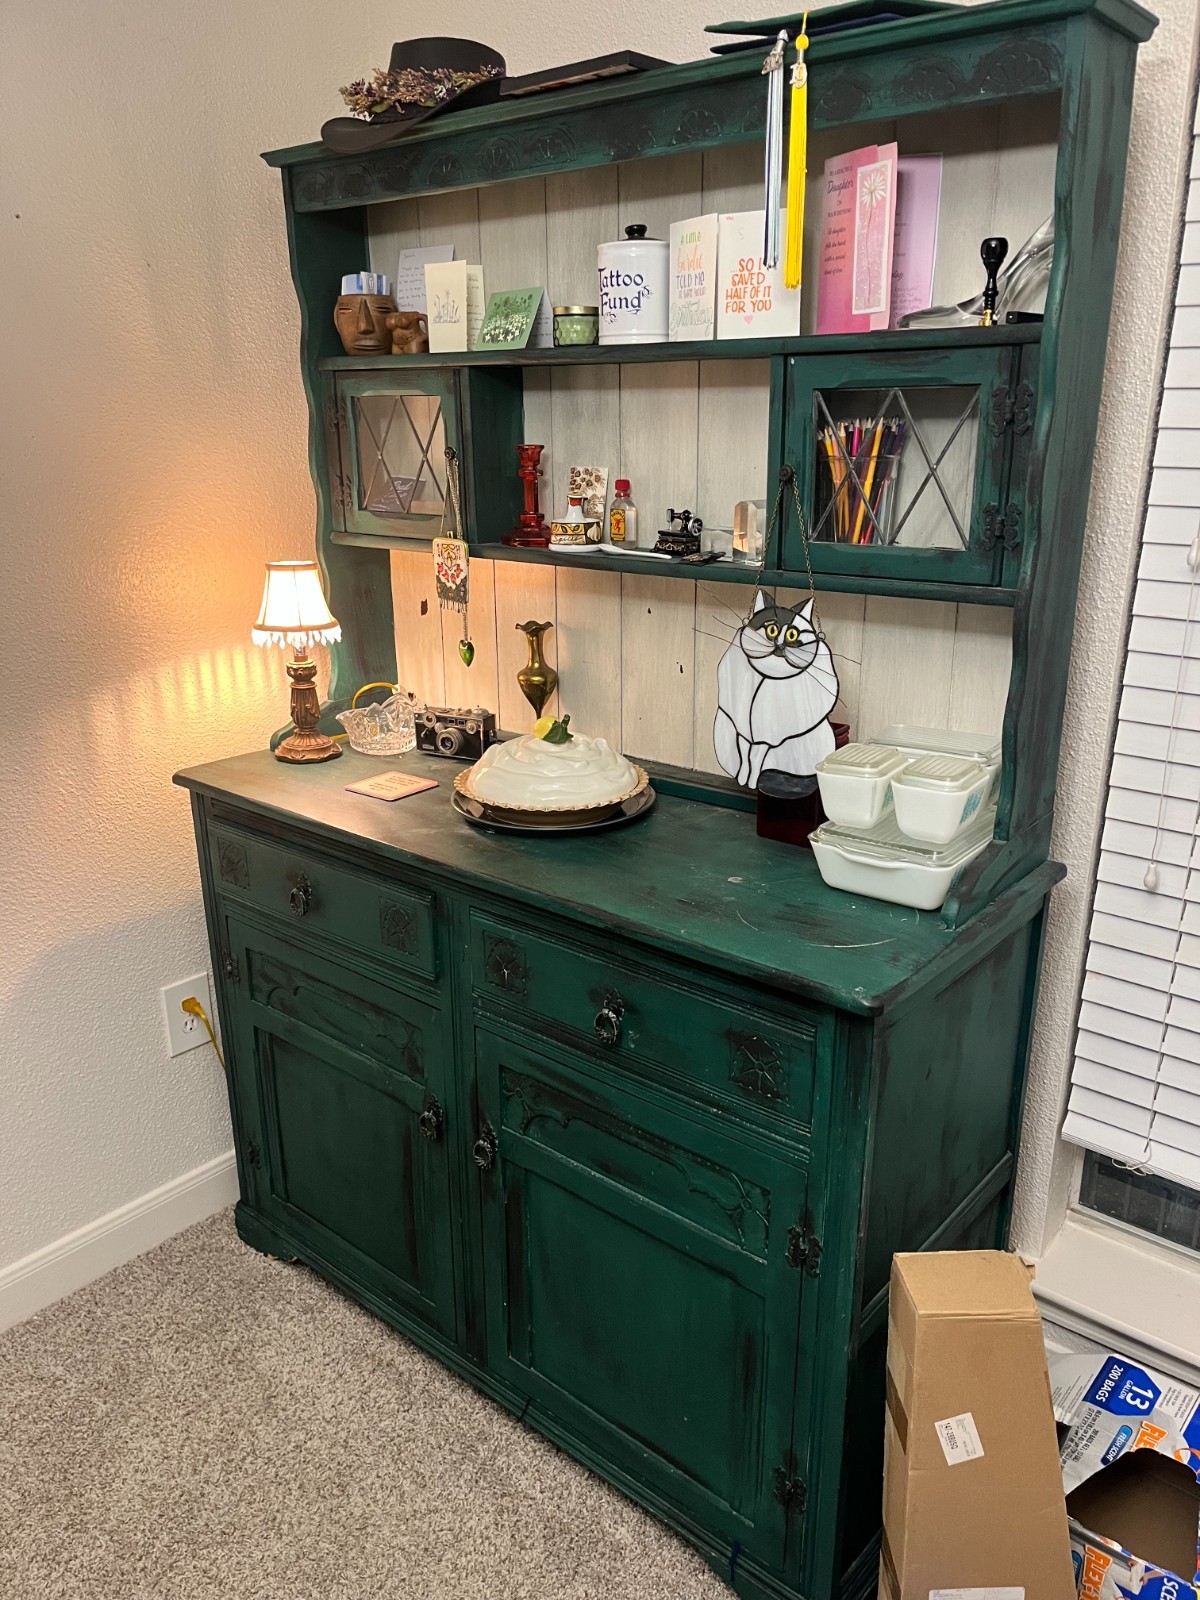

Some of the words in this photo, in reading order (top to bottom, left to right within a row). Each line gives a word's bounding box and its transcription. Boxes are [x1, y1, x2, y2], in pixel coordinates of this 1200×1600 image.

[827, 179, 853, 198] Daughter
[758, 257, 762, 270] I
[598, 267, 644, 292] Tattoo
[676, 273, 692, 289] TOLD
[732, 272, 766, 287] SAVED
[726, 286, 748, 300] HALF
[750, 286, 761, 299] OF
[763, 286, 772, 298] IT
[600, 290, 642, 316] Fund
[726, 300, 746, 313] FOR
[750, 300, 772, 312] YOU
[1109, 1365, 1123, 1380] 200
[1096, 1379, 1115, 1402] BAGS
[1118, 1380, 1134, 1399] GALLON
[1126, 1386, 1154, 1410] 13
[1116, 1432, 1127, 1446] FRESH
[1106, 1445, 1119, 1461] SCENT
